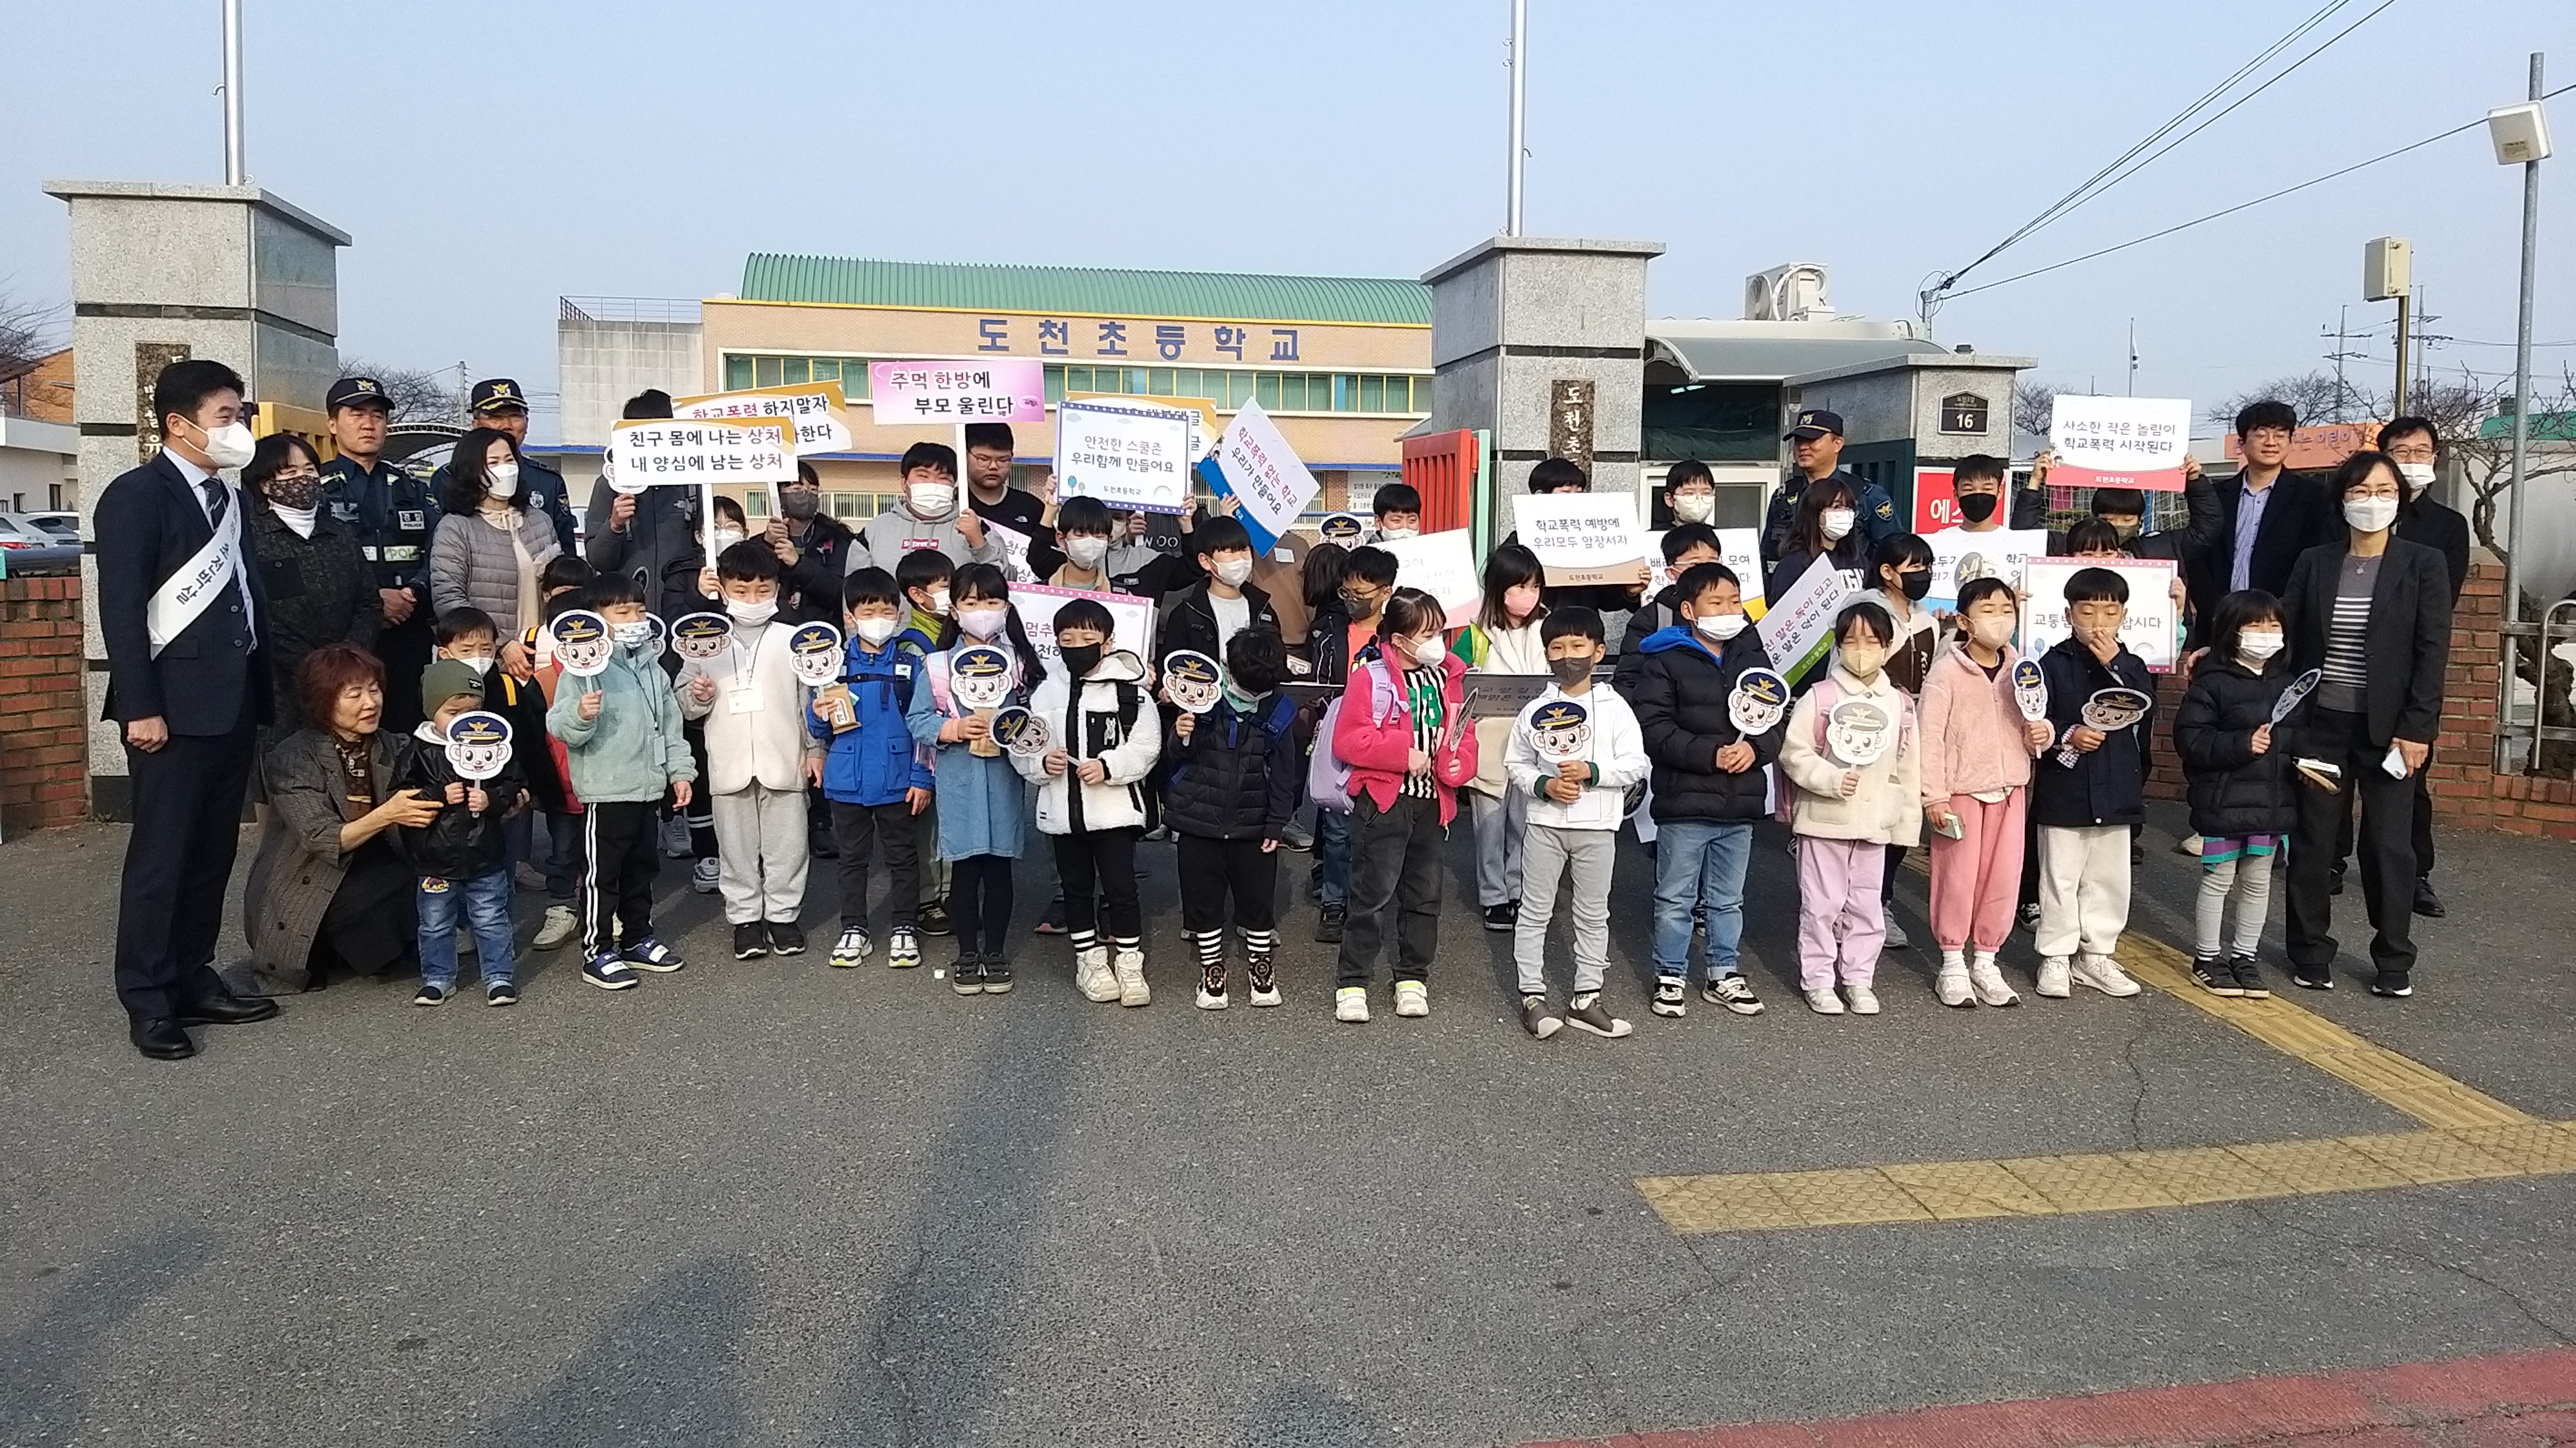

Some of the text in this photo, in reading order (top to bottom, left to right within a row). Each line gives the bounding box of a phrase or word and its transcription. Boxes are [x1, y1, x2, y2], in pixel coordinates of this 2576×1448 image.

[978, 319, 1299, 361] 도천초등학교
[891, 371, 991, 390] 주먹 한방에
[764, 395, 828, 416] 하지말자
[914, 397, 952, 415] 부모
[957, 397, 1014, 415] 울린다
[1956, 413, 1974, 429] 16
[2063, 420, 2176, 436] 사소한 작은 놀림이
[630, 427, 782, 447] 친구 몸에 나는 상처
[794, 424, 833, 444] 한다
[1085, 436, 1162, 455] 안전한 스쿨존
[2064, 437, 2173, 454] 학교폭력 시작된다
[631, 453, 782, 472] 내 양심에 남는 상처
[1071, 452, 1174, 473] 우리함께 만들어요
[1238, 426, 1298, 508] 학교폭력 없는 학교
[1231, 447, 1282, 516] 우리가 만들어요
[1535, 518, 1620, 532] 학교폭력 예방에
[1534, 535, 1628, 549] 우리모두 앞장서자
[1728, 554, 1750, 566] 모여
[1775, 619, 1795, 641] 말은
[1795, 597, 1814, 619] 독이
[1814, 577, 1833, 600] 되고
[1781, 632, 1801, 653] 말은
[1801, 609, 1821, 630] 덕이
[1821, 588, 1840, 611] 된다
